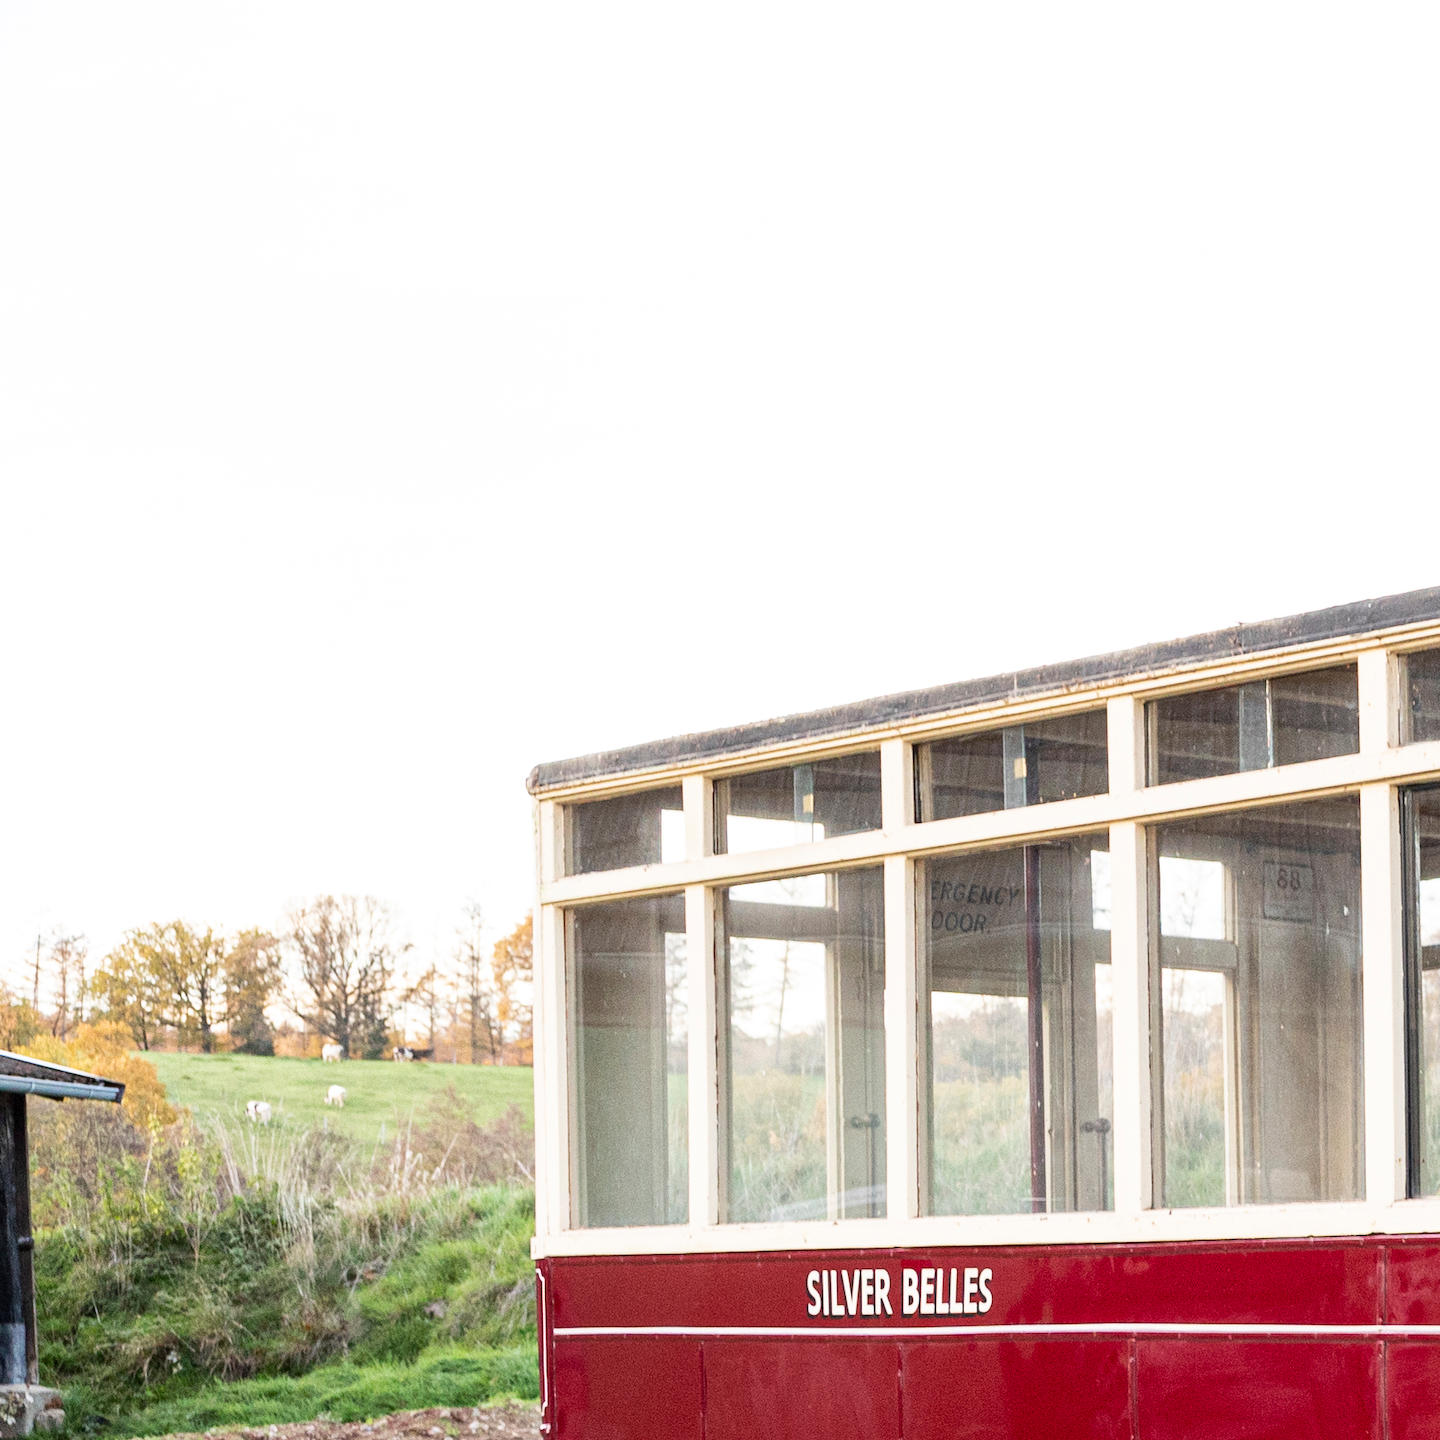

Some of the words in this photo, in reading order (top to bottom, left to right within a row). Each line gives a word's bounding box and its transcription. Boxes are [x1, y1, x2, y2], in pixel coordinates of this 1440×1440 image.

[931, 880, 1020, 906] ERGENCY
[806, 1269, 893, 1317] SILVER
[902, 1267, 994, 1316] BELLES
